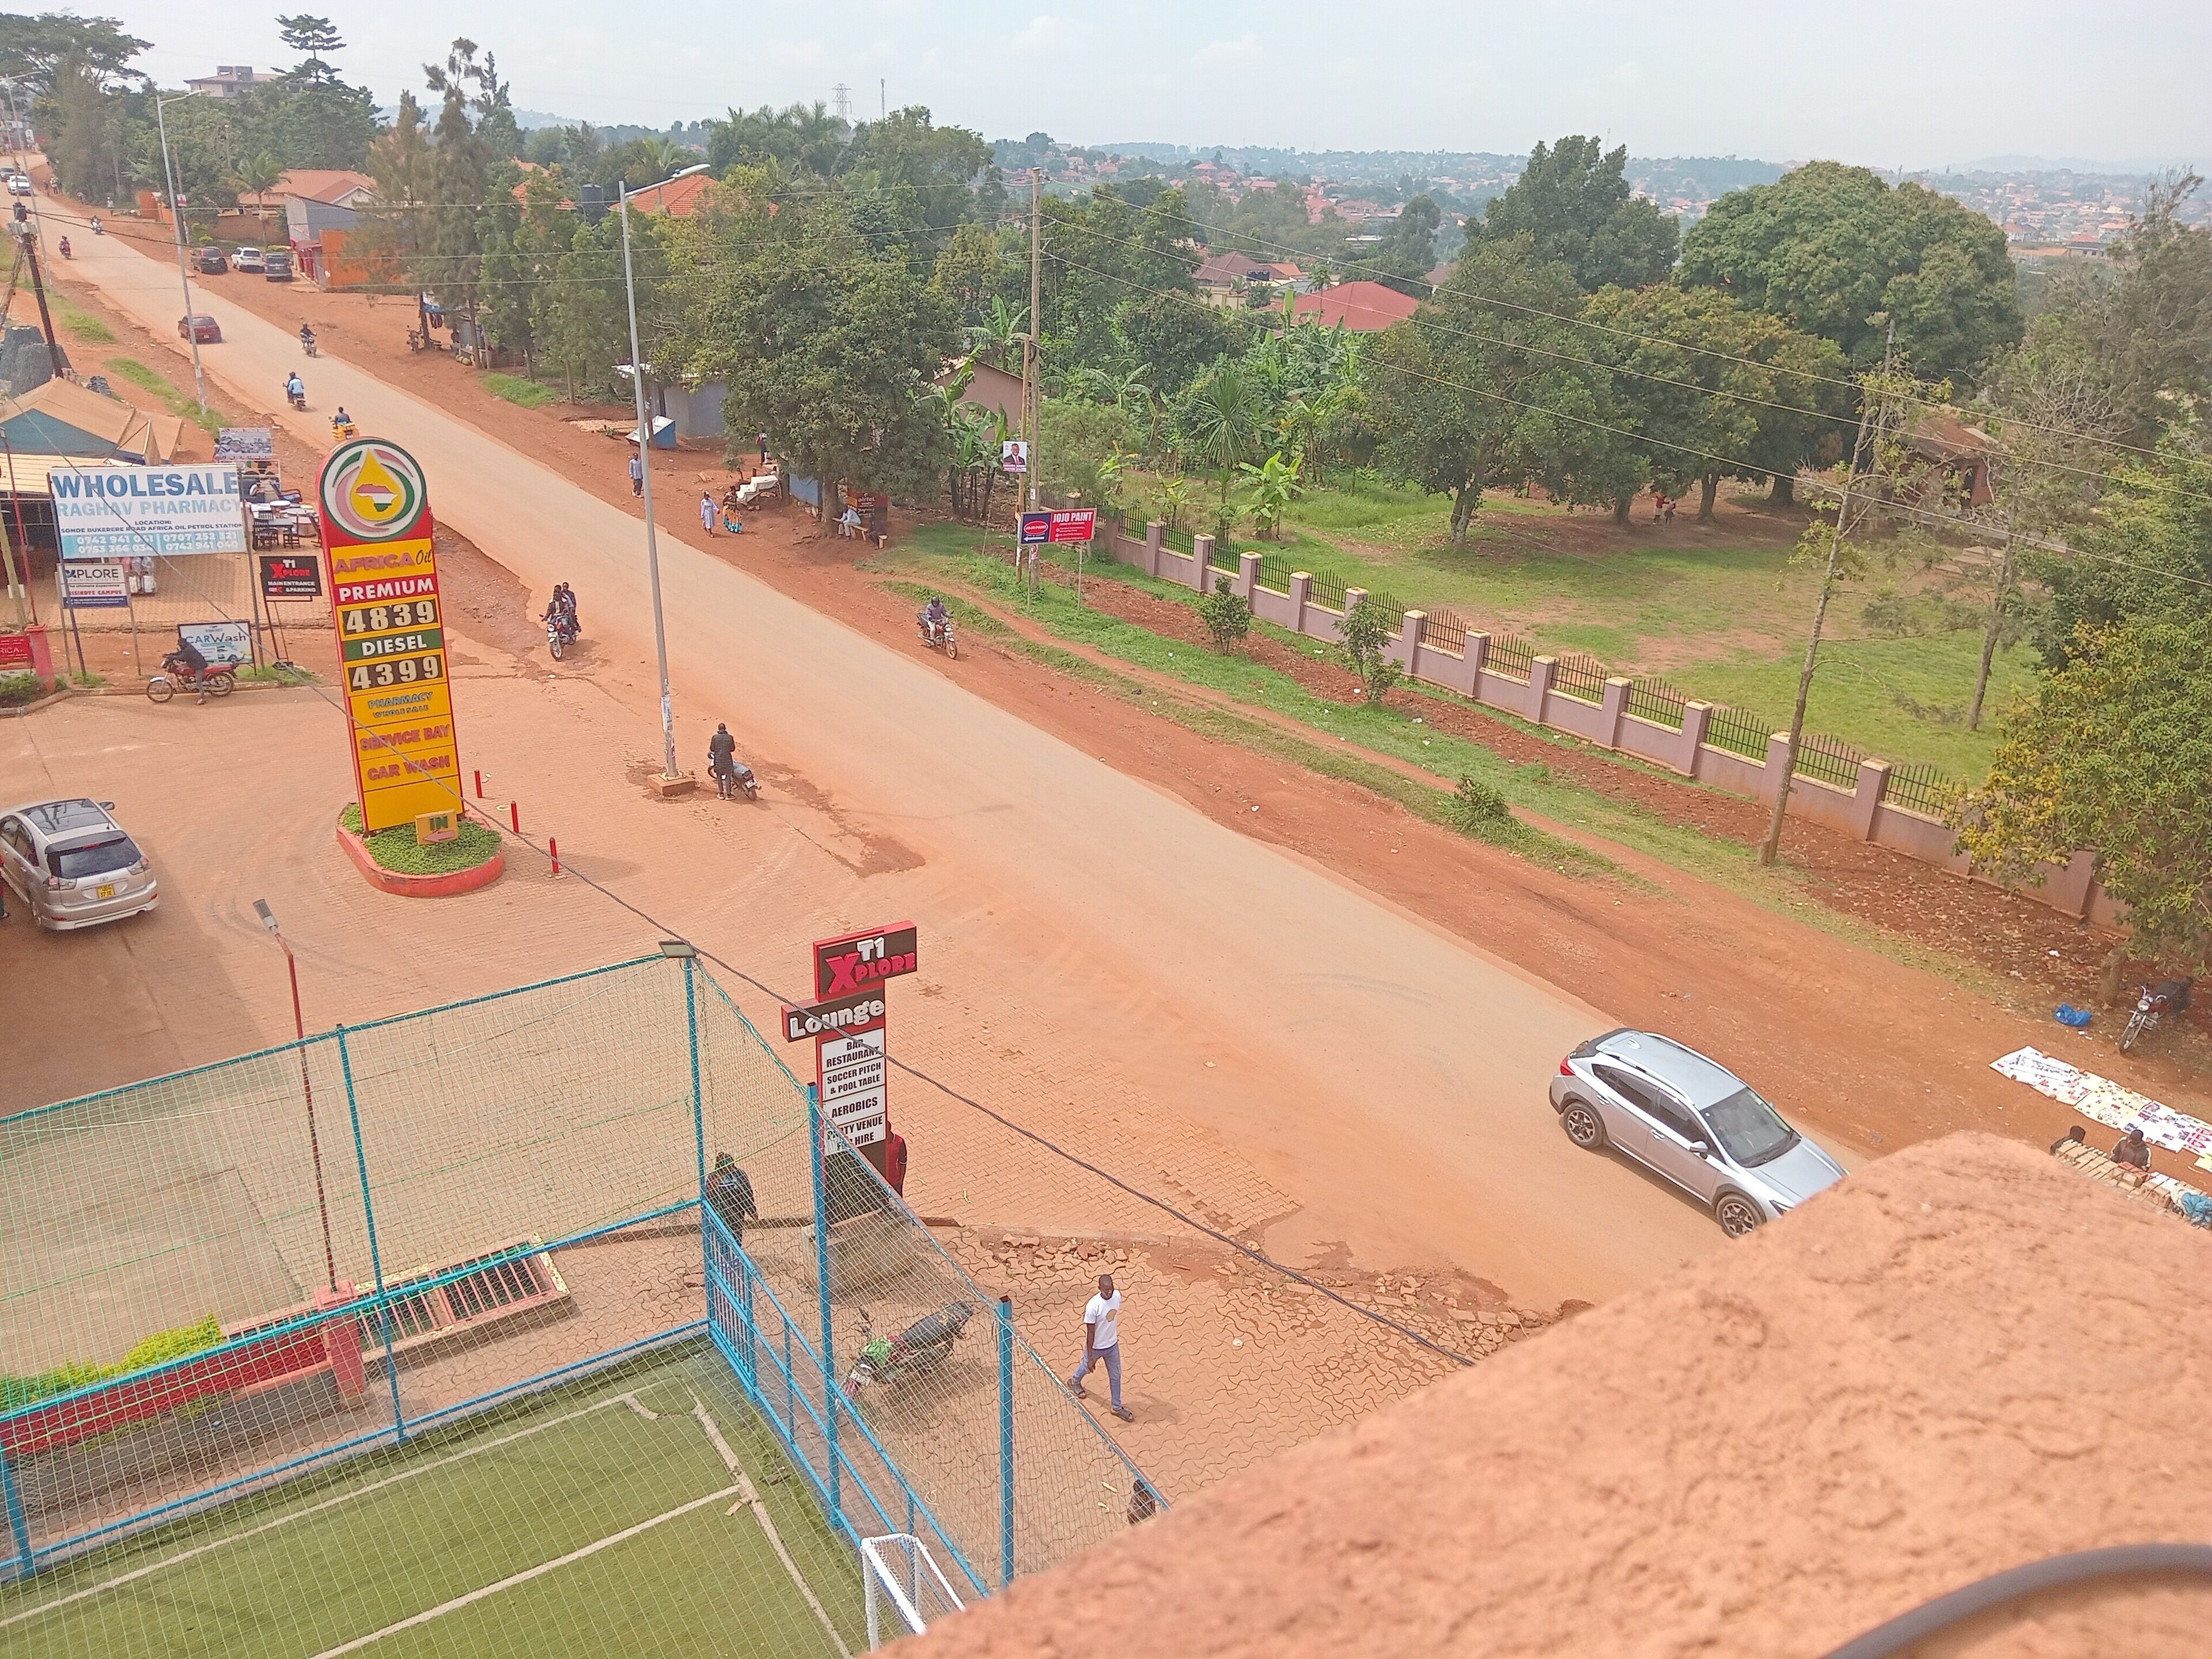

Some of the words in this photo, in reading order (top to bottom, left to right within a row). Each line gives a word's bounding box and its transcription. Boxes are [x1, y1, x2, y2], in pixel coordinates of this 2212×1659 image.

[52, 472, 238, 498] WHOLESALE
[58, 501, 132, 517] RAGHAV
[140, 499, 240, 515] PHARMACY
[1052, 513, 1070, 523] JOJO
[1070, 512, 1093, 522] PAINT
[163, 533, 192, 541] 0707
[282, 559, 296, 568] T1
[334, 552, 416, 574] AFRICA
[416, 549, 431, 565] Oil
[339, 578, 434, 602] PREMIUM
[346, 601, 434, 633] 4839
[362, 634, 427, 656] DIESEL
[352, 656, 438, 690] 4399
[368, 691, 433, 709] PHARMACY
[360, 729, 421, 751] SERVICE
[423, 724, 450, 740] BAY
[368, 764, 400, 781] CAR
[404, 755, 450, 774] WASH
[430, 816, 448, 831] IN
[857, 937, 885, 961] T1
[825, 952, 915, 993] XPLORE
[790, 999, 885, 1038] Lounge
[847, 1039, 864, 1051] BAR
[826, 1046, 880, 1068] RESTAURANT
[827, 1069, 857, 1084] SOCCER
[859, 1062, 881, 1075] PITCH
[838, 1081, 857, 1093] POOL
[858, 1074, 880, 1087] TABLE
[831, 1097, 878, 1118] AEROBICS
[856, 1116, 882, 1131] VENUE
[855, 1132, 874, 1146] HIRE
